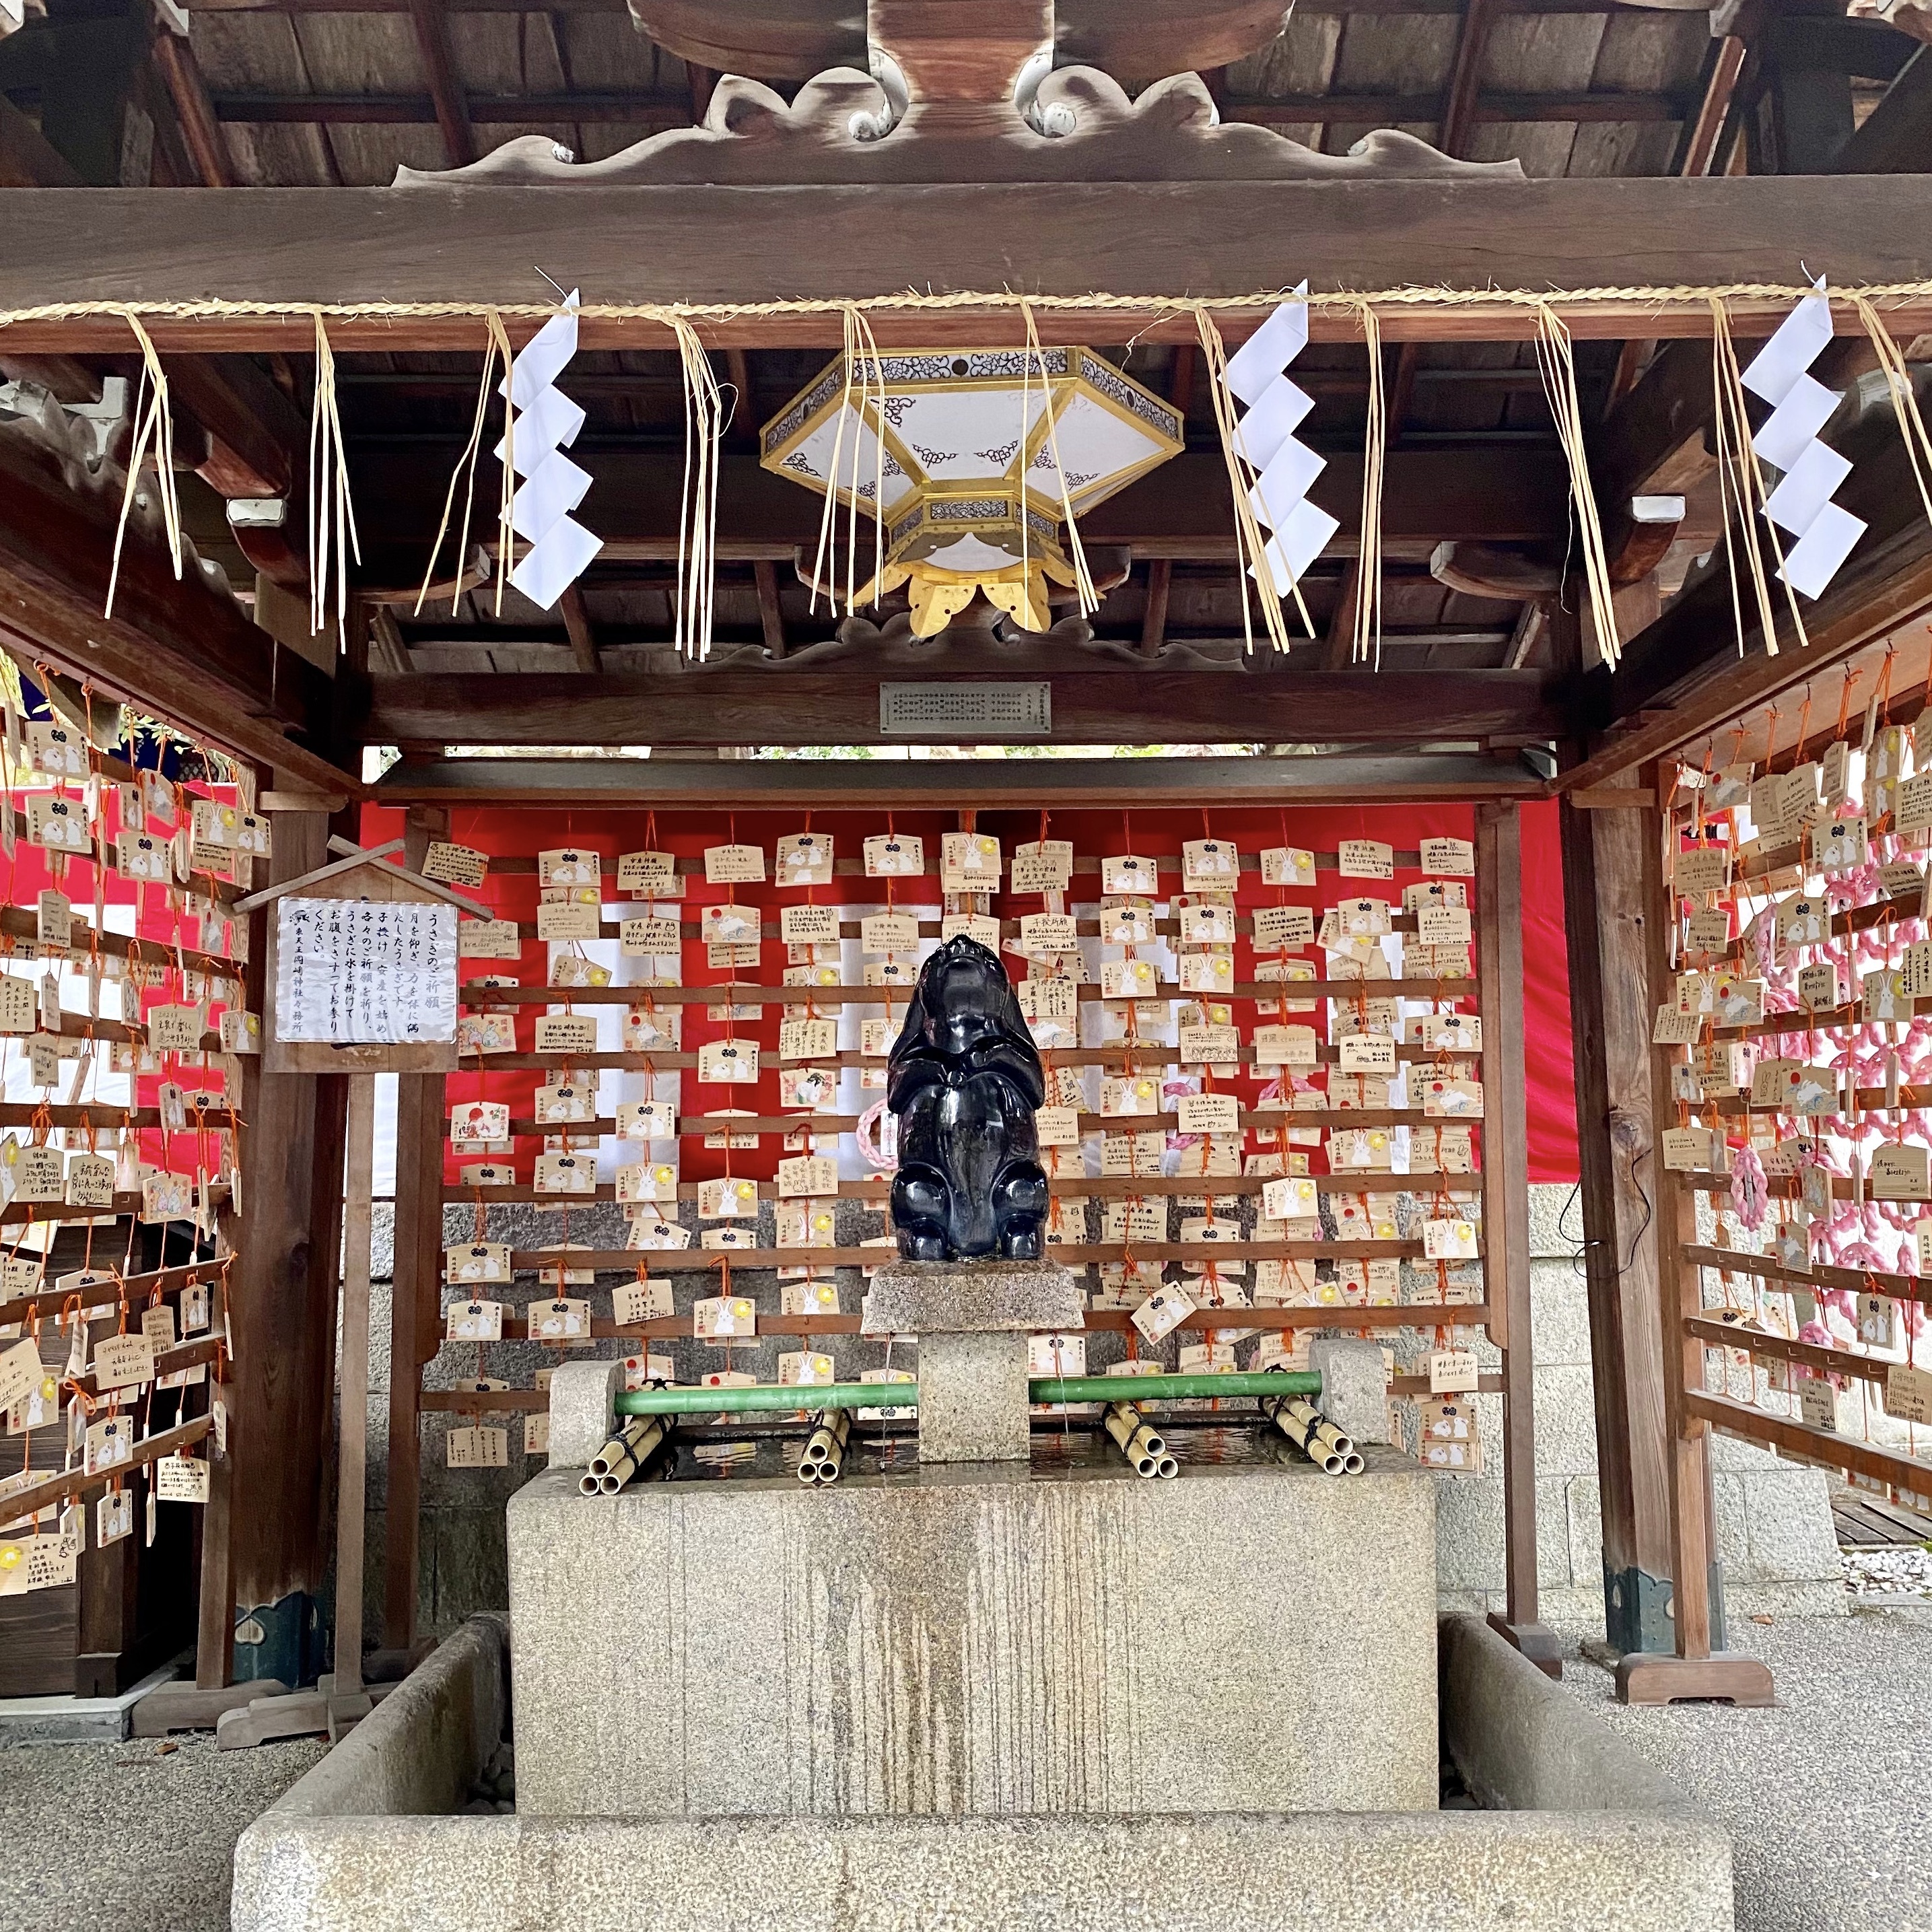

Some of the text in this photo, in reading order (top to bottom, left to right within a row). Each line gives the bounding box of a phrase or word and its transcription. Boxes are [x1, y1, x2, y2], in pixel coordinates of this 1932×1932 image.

[314, 909, 324, 959] ください。
[328, 910, 342, 1033] お腹をさすってお参り
[343, 911, 357, 1019] うさぎに水を掛けて
[425, 913, 440, 1009] うさぎのご祈願
